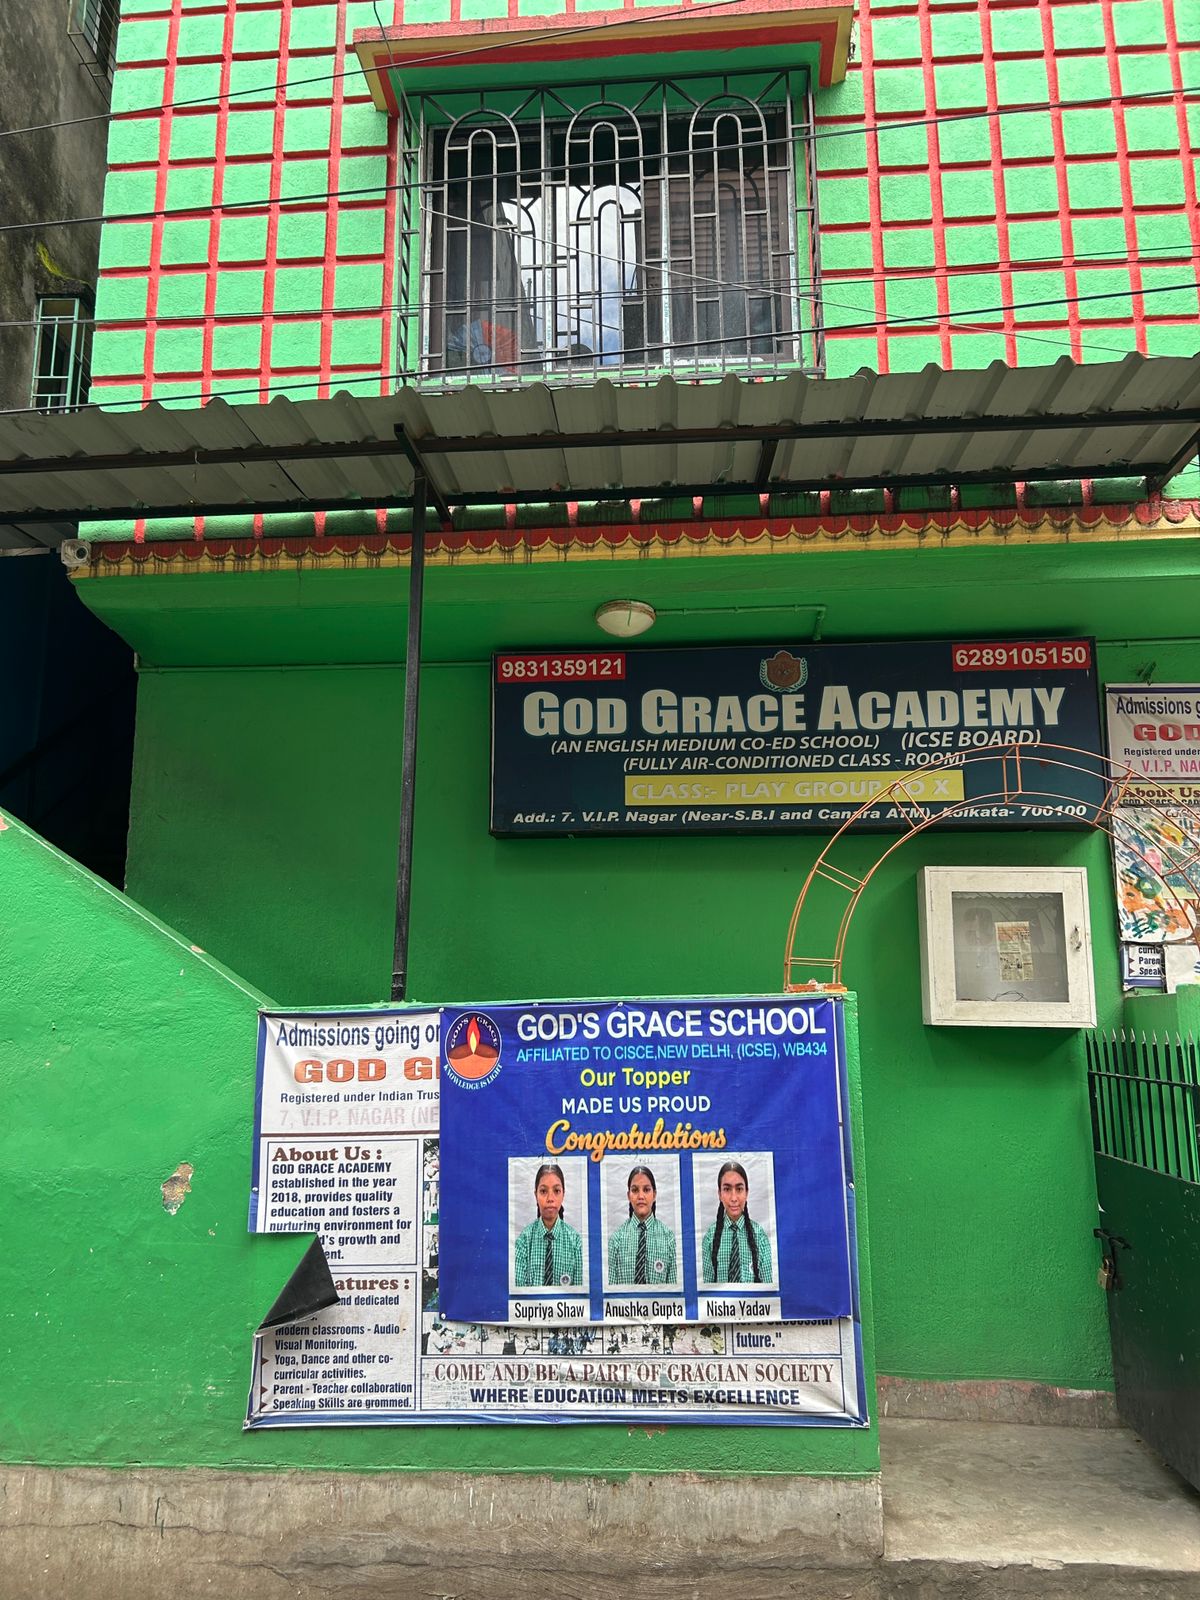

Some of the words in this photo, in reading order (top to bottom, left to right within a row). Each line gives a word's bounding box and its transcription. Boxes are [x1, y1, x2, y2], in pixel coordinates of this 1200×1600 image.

[955, 646, 1087, 667] 6289105150
[502, 658, 623, 678] 9831359121
[523, 691, 627, 737] GOD
[641, 689, 806, 735] GRACE
[817, 685, 1066, 731] ACADEMY
[1116, 696, 1192, 715] Admissions
[551, 740, 583, 755] (AN
[584, 740, 657, 753] ENGLISH
[662, 738, 736, 752] MEDIUM
[740, 737, 796, 751] CO-ED
[800, 734, 880, 750] SCHOOL)
[901, 731, 955, 750] (ICSE
[958, 729, 1041, 748] BOARD)
[1124, 748, 1172, 757] Registered
[623, 757, 677, 772] (FULLY
[681, 752, 835, 770] AIR-CONDITIONED
[839, 752, 891, 767] CLASS
[904, 752, 966, 767] ROOM)
[632, 783, 717, 800] CLASS:-
[726, 781, 785, 799] PLAY
[795, 780, 881, 797] GROUP
[933, 779, 950, 796] X
[1121, 788, 1175, 798] About
[513, 811, 555, 823] Add.:
[582, 811, 619, 823] V.I.P.
[625, 811, 677, 825] Nagar
[681, 810, 774, 824] (Near-S.B.I
[781, 809, 812, 820] and
[817, 808, 880, 820] Canara
[516, 1010, 599, 1042] GOD'S
[606, 1010, 706, 1039] GRACE
[709, 1007, 827, 1037] SCHOOL
[276, 1022, 370, 1046] Admissions
[375, 1020, 420, 1051] going
[516, 1047, 590, 1062] AFFILIATED
[592, 1047, 611, 1060] TO
[691, 1044, 735, 1060] DELHI,
[737, 1043, 780, 1061] (ICSE),
[784, 1042, 828, 1056] WB434
[294, 1058, 386, 1083] GOD
[580, 1069, 616, 1086] Our
[622, 1068, 691, 1089] Topper
[280, 1093, 340, 1104] Registered
[344, 1093, 375, 1102] under
[379, 1091, 413, 1101] Indian
[562, 1098, 617, 1114] MADE
[619, 1097, 643, 1113] US
[647, 1096, 711, 1113] PROUD
[301, 1109, 341, 1126] V.I.P.
[349, 1107, 405, 1125] NAGAR
[545, 1118, 727, 1162] Congratulations
[272, 1147, 339, 1162] About
[344, 1146, 371, 1161] Us
[272, 1163, 294, 1174] GOD
[298, 1163, 334, 1174] GRACE
[338, 1162, 392, 1173] ACADEMY
[271, 1178, 335, 1188] established
[338, 1177, 349, 1187] in
[352, 1177, 369, 1187] the
[372, 1177, 397, 1190] year
[271, 1192, 301, 1203] 2018,
[304, 1192, 352, 1206] provides
[355, 1191, 393, 1205] quality
[270, 1206, 325, 1217] education
[328, 1206, 350, 1216] and
[352, 1205, 389, 1216] fosters
[393, 1208, 400, 1216] a
[269, 1220, 320, 1232] nurturing
[324, 1220, 394, 1231] environment
[396, 1220, 412, 1230] for
[338, 1235, 377, 1247] growth
[380, 1234, 401, 1244] and
[354, 1295, 399, 1306] dedicated
[515, 1303, 554, 1320] Supriya
[557, 1302, 585, 1317] Shaw
[605, 1301, 649, 1317] Anushka
[652, 1301, 683, 1320] Gupta
[706, 1301, 736, 1317] Nisha
[739, 1300, 771, 1317] Yadav
[312, 1325, 365, 1336] classrooms
[374, 1324, 400, 1335] Audio
[275, 1339, 302, 1350] Visual
[304, 1339, 357, 1351] Monitoring.
[736, 1332, 782, 1348] future."
[275, 1354, 299, 1366] Yoga,
[301, 1354, 330, 1365] Dance
[333, 1354, 350, 1364] and
[352, 1353, 376, 1364] other
[378, 1355, 393, 1364] co-
[274, 1368, 319, 1380] curricular
[321, 1367, 367, 1379] activities.
[435, 1363, 486, 1382] COME
[492, 1363, 529, 1382] AND
[536, 1363, 559, 1382] BE
[565, 1363, 578, 1382] A
[583, 1363, 631, 1382] PART
[637, 1363, 661, 1383] OF
[667, 1363, 749, 1383] GRACIAN
[755, 1363, 834, 1383] SOCIETY
[273, 1384, 304, 1395] Parent
[313, 1383, 349, 1394] Teacher
[351, 1382, 412, 1394] collaboration
[470, 1388, 529, 1404] WHERE
[534, 1388, 626, 1404] EDUCATION
[632, 1389, 689, 1404] MEETS
[693, 1389, 801, 1406] EXCELLENCE
[273, 1399, 316, 1410] Speaking
[318, 1398, 345, 1408] Skills
[347, 1399, 362, 1408] are
[364, 1397, 412, 1409] grommed.
